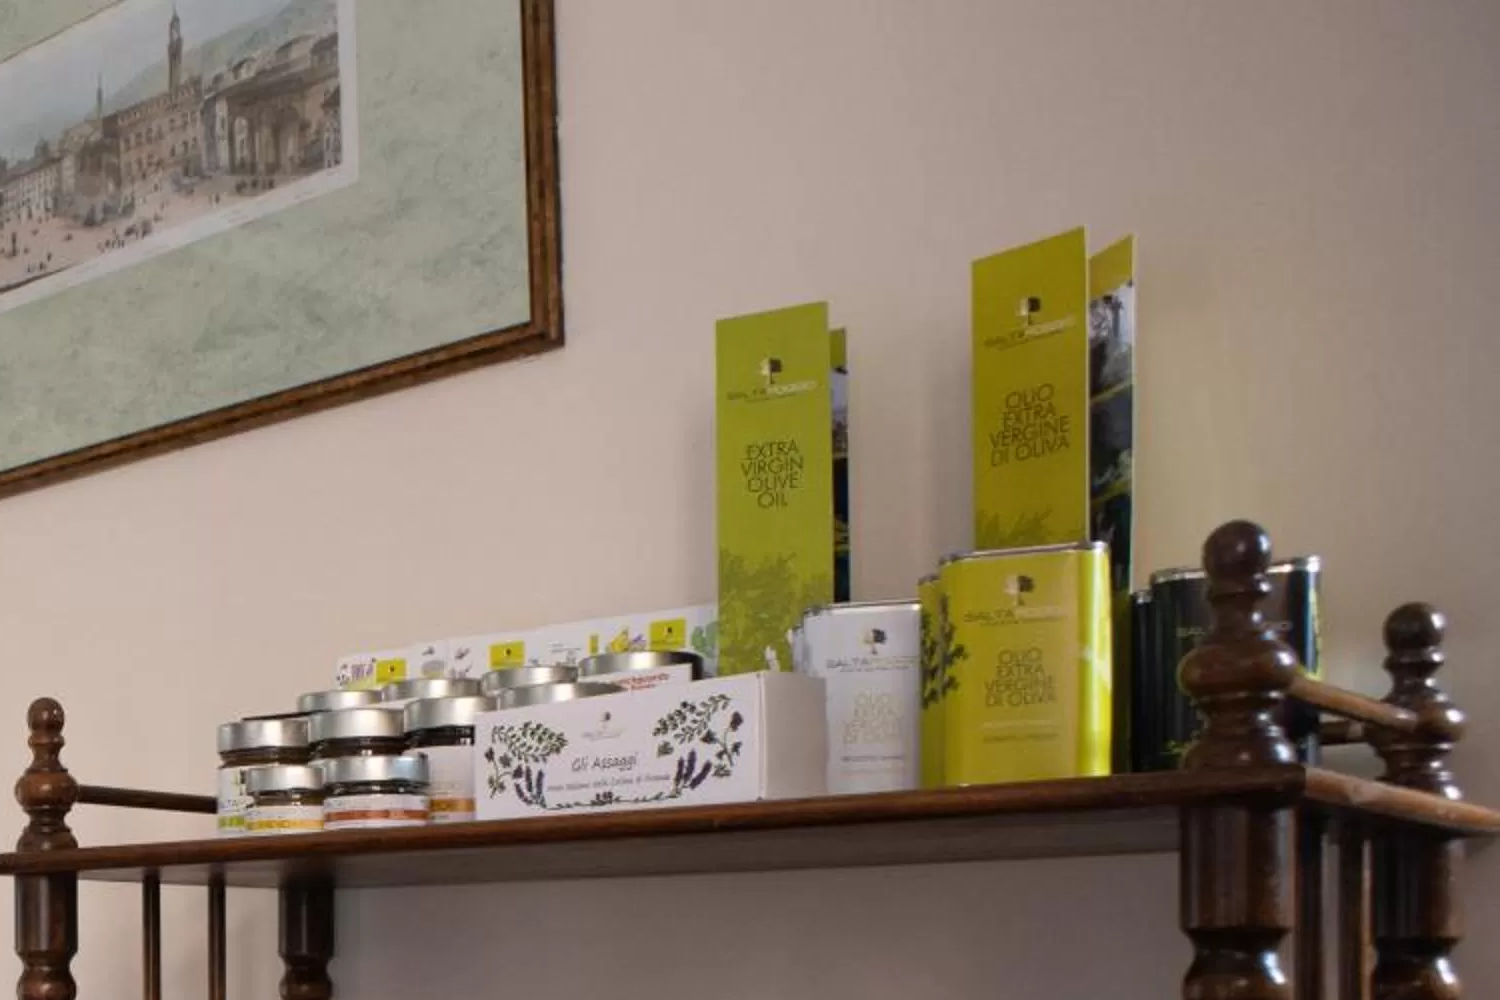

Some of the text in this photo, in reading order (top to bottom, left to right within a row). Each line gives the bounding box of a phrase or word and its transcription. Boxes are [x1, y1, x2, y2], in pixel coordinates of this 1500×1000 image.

[1005, 383, 1054, 408] OLIO
[1003, 402, 1056, 429] EXTRA
[989, 415, 1070, 448] VERGINE
[745, 439, 800, 460] EXTRA
[991, 434, 1070, 467] DI OLIVA
[740, 457, 804, 476] VIRGIN
[747, 473, 799, 493] OLIVE
[757, 491, 788, 509] OIL
[997, 648, 1042, 665] OLIO
[572, 753, 637, 772] Gli Assaggi
